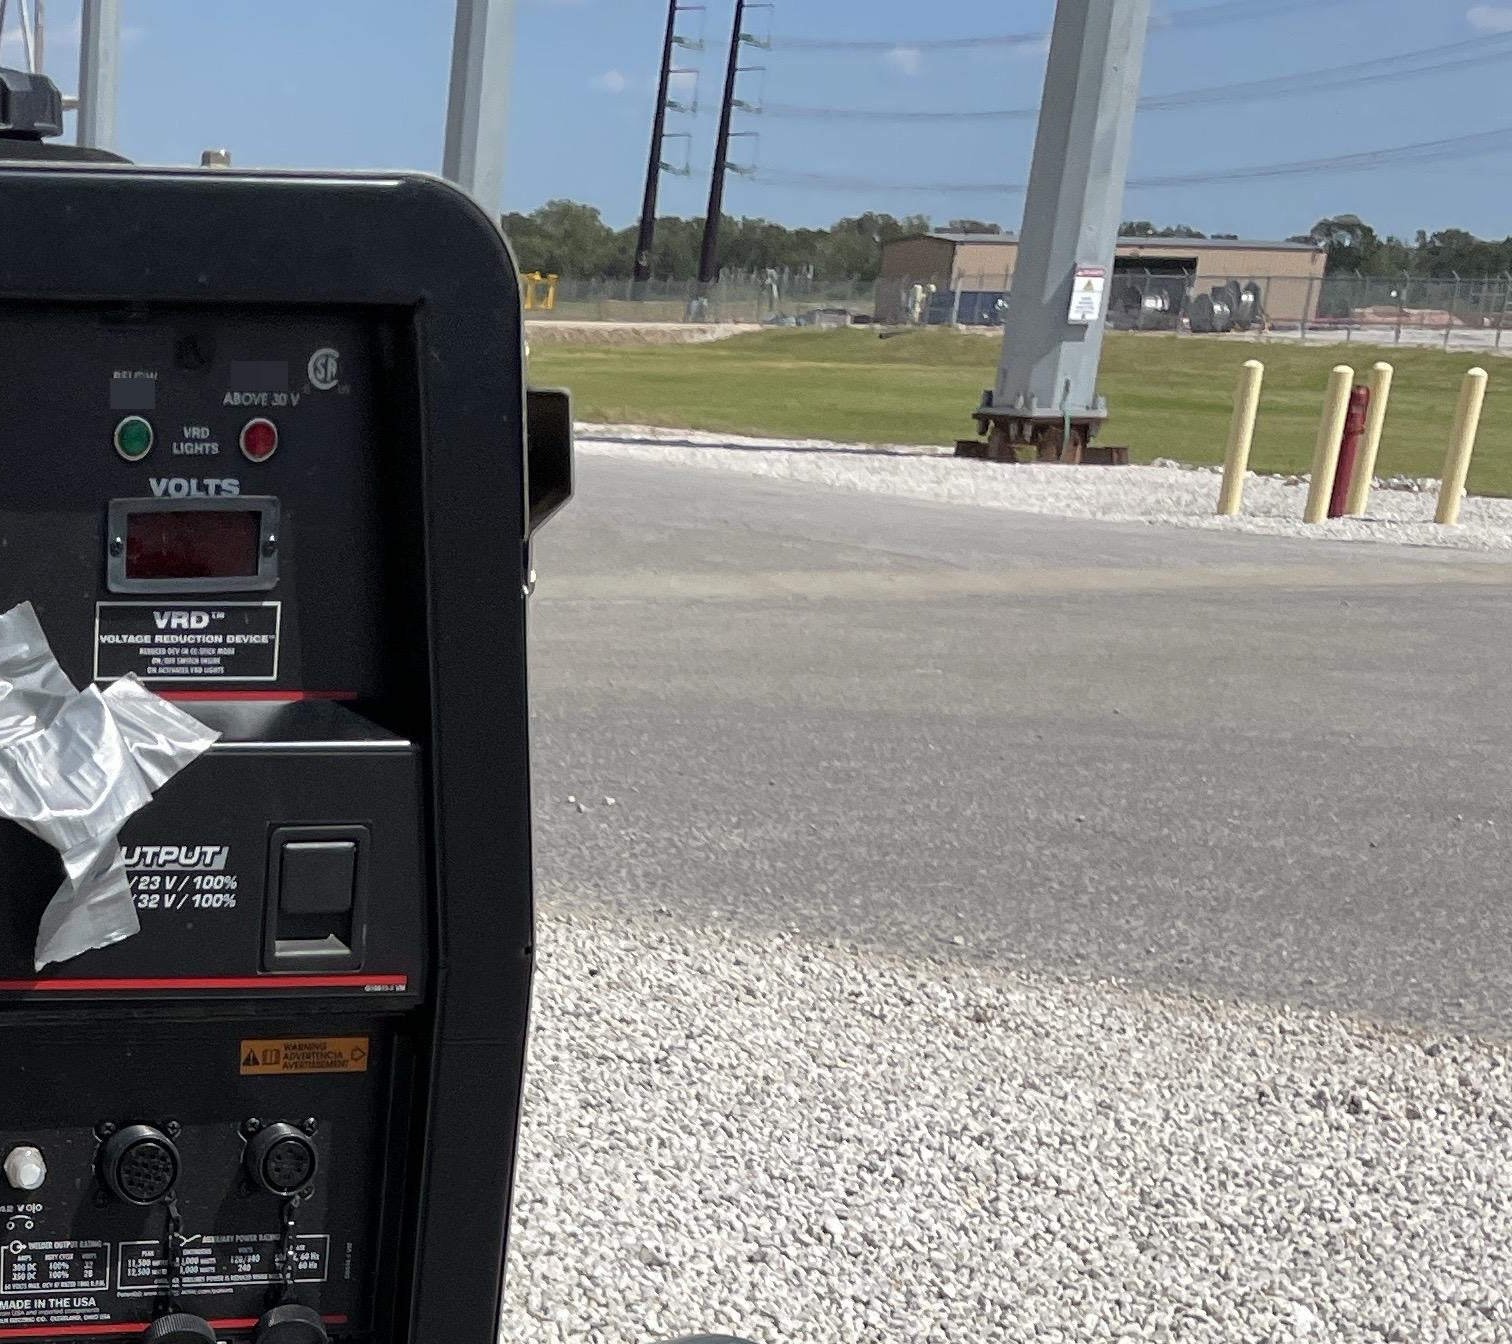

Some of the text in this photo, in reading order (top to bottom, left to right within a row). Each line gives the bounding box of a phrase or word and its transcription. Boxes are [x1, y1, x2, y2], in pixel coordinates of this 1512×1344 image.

[223, 392, 301, 406] ABOVE 30 V
[184, 427, 210, 439] VRD
[173, 442, 219, 455] LIGHTS
[149, 477, 240, 497] VOLTS
[99, 634, 223, 644] VOLTAGE REDUCTION
[120, 846, 221, 867] UTPUT
[138, 876, 161, 890] 23
[193, 875, 238, 890] 100%
[137, 894, 160, 908] 32
[192, 894, 237, 908] 100%
[0, 1297, 96, 1310] MADE IN THE USA
